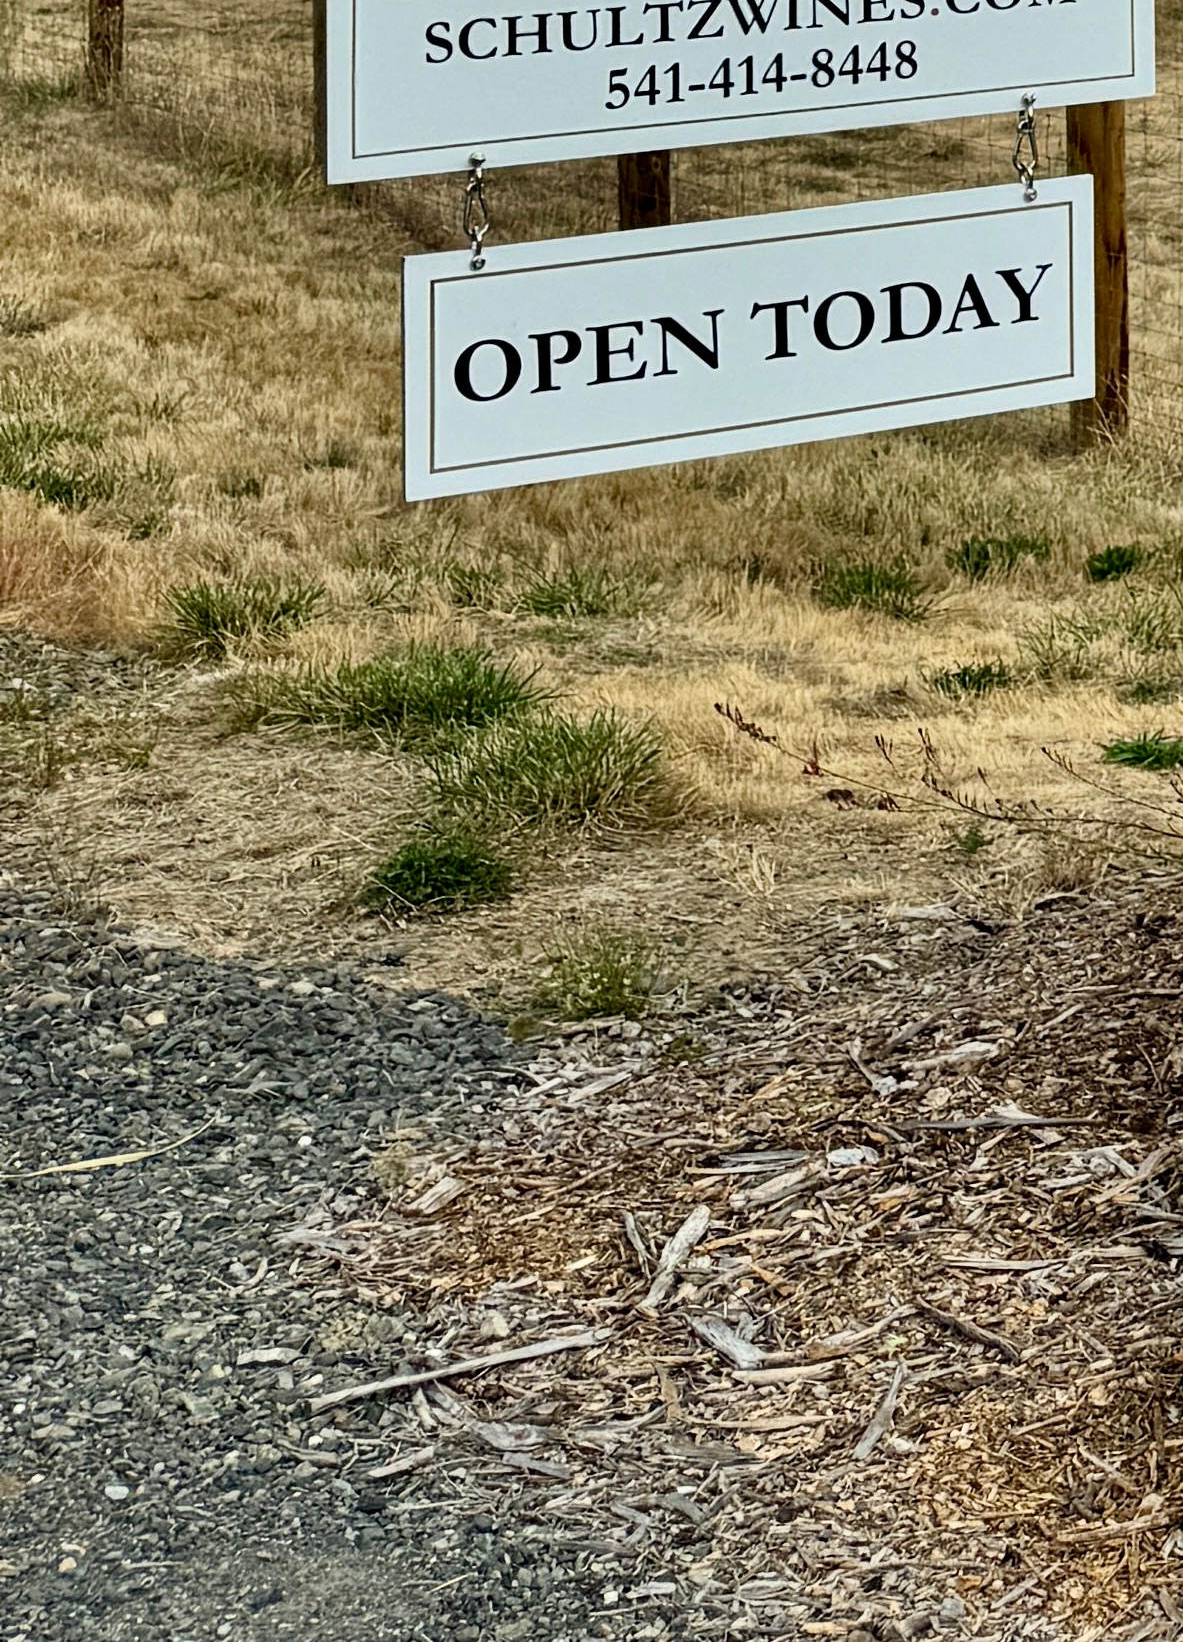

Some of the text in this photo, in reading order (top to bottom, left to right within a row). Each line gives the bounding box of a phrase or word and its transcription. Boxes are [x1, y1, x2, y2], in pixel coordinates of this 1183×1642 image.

[604, 39, 918, 110] 541-414-8448
[453, 262, 1053, 402] OPEN TODAY
